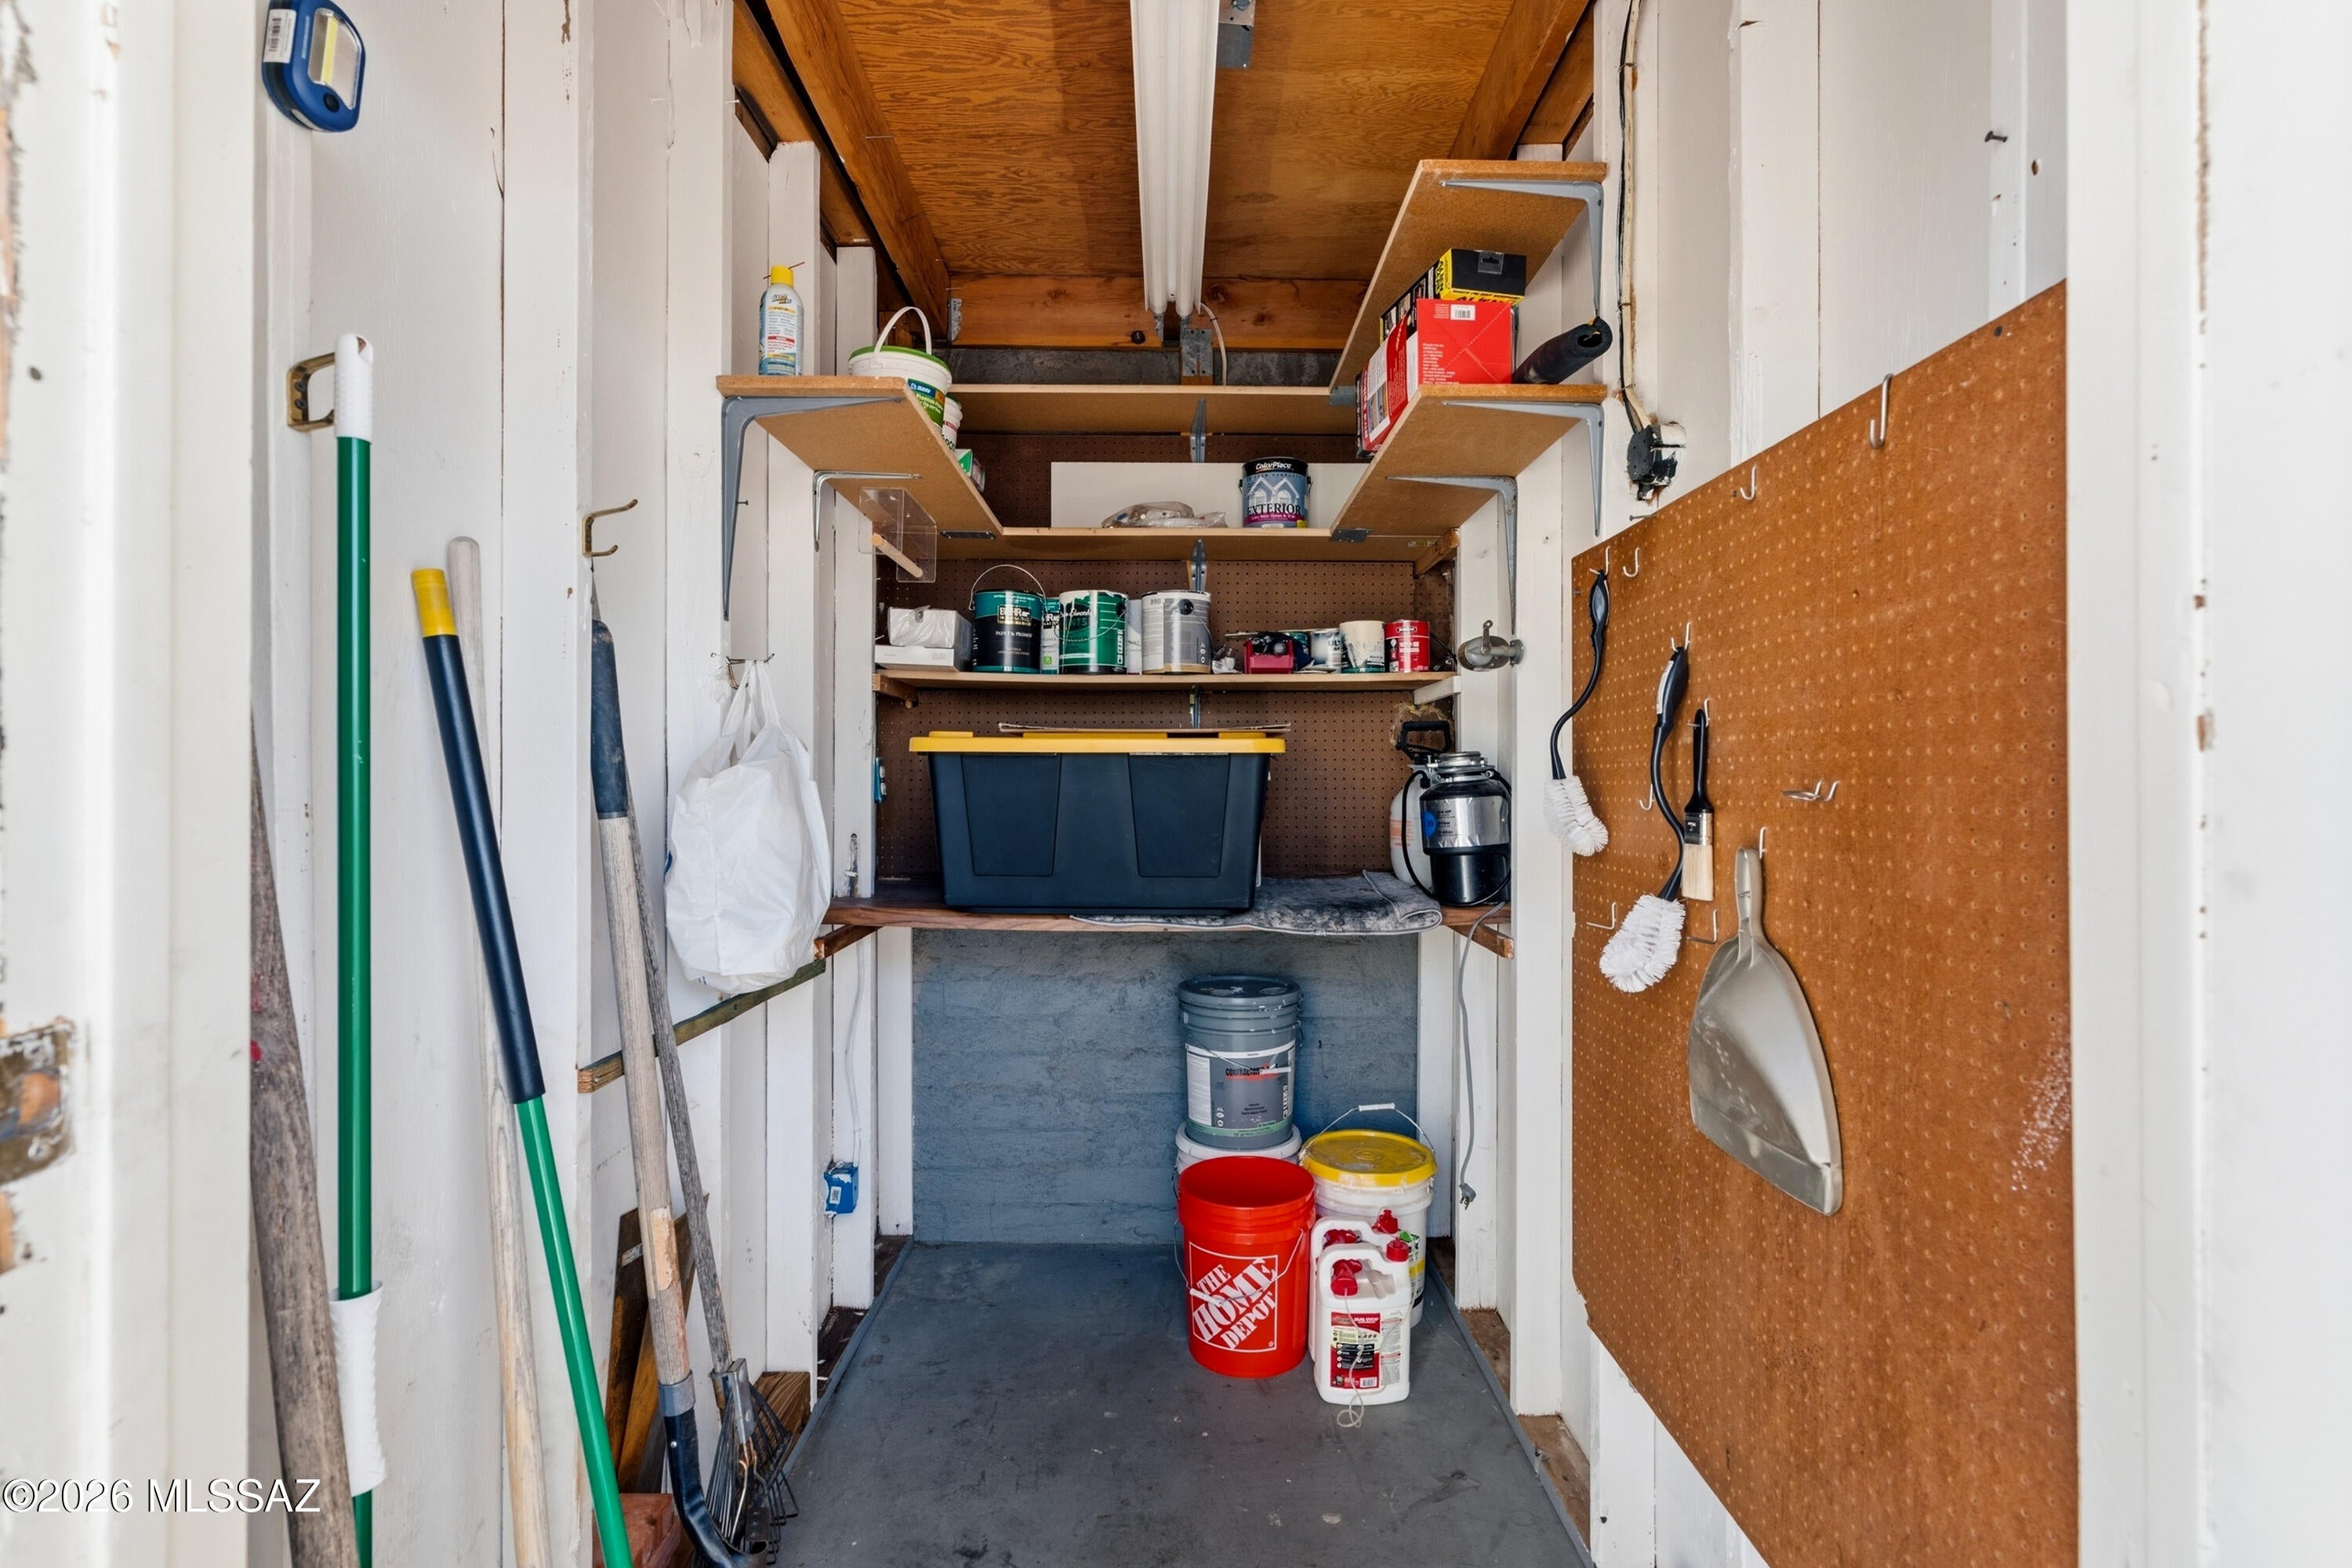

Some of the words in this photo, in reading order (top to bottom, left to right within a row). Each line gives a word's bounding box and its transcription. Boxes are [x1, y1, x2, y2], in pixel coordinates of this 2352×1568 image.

[1247, 503, 1301, 516] EXTERIOR
[1192, 1258, 1277, 1342] HOME
[1196, 1264, 1232, 1294] THE
[1220, 1291, 1277, 1349] DEPOT
